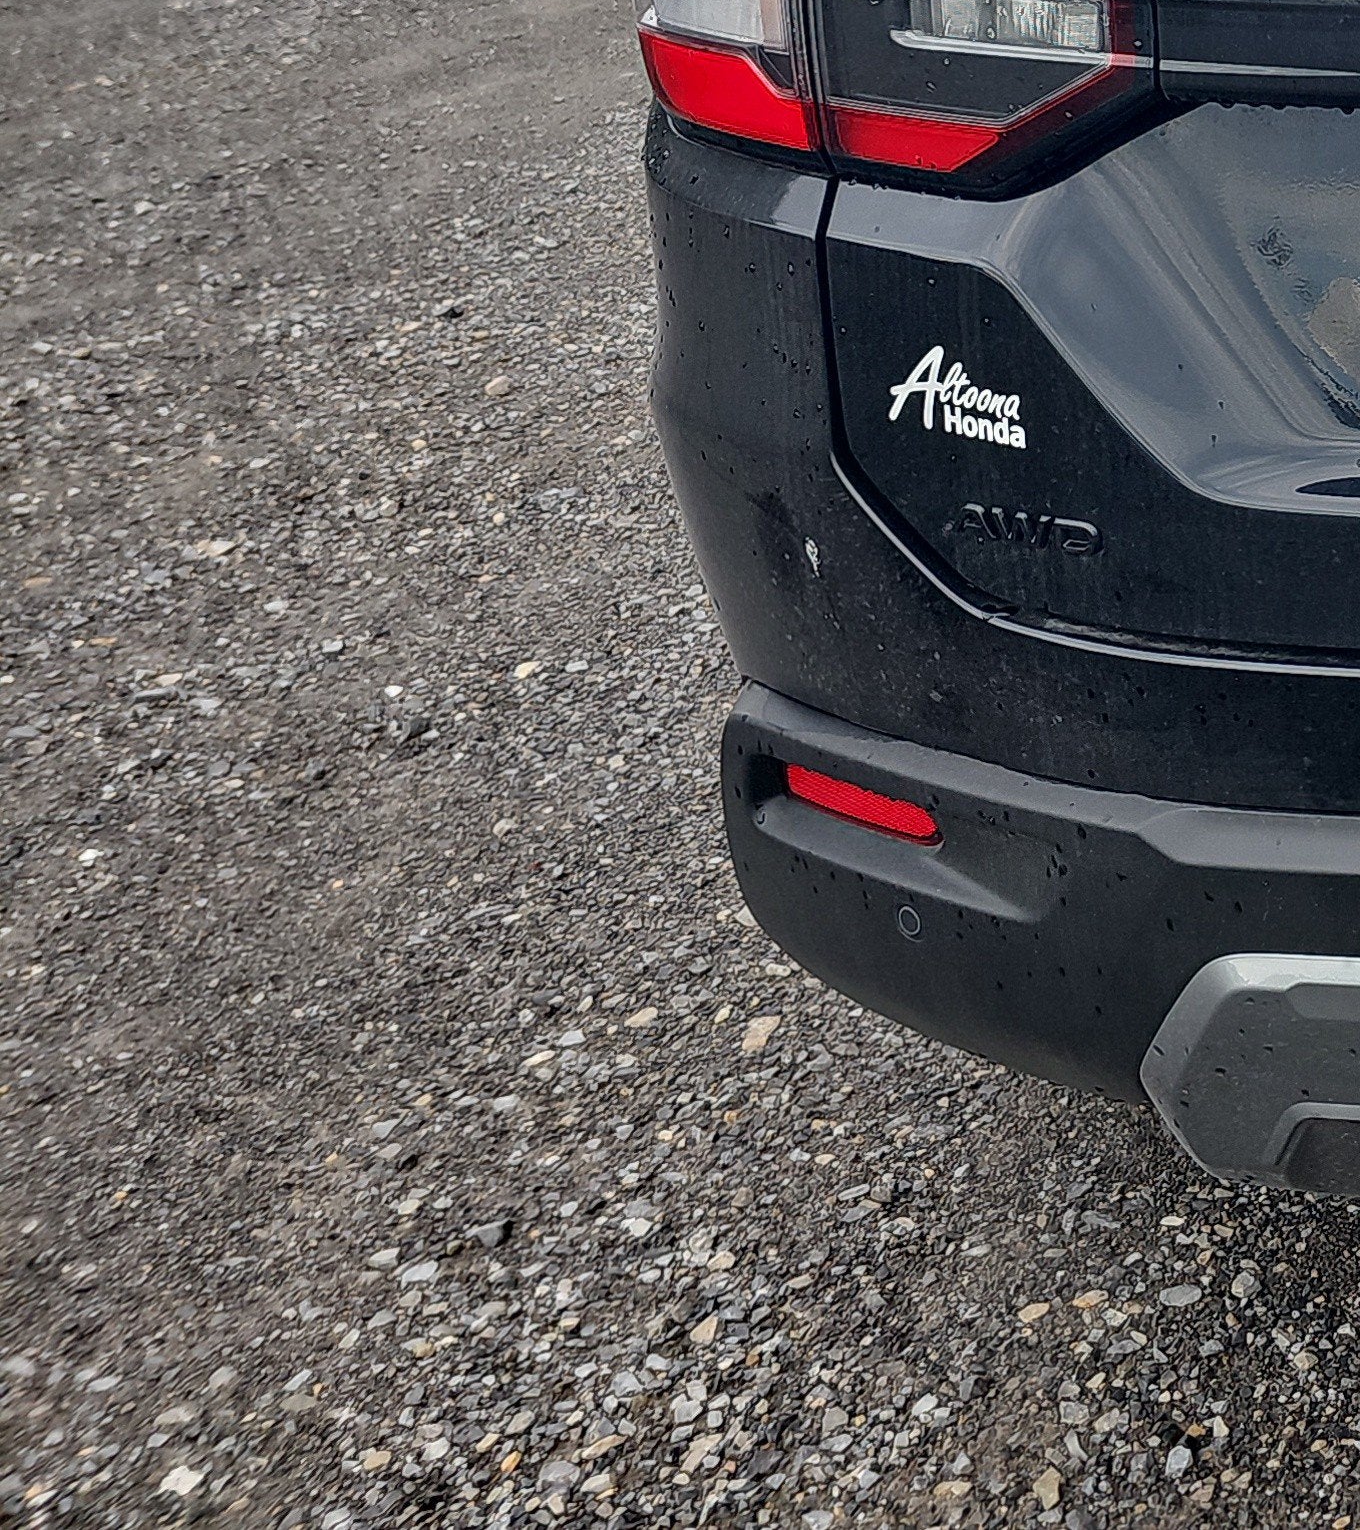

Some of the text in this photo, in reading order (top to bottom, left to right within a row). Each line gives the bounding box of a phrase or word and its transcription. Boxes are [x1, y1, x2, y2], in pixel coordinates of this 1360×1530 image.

[888, 345, 1021, 430] Altoona
[943, 404, 1027, 450] Honda
[956, 503, 1104, 554] AWD
